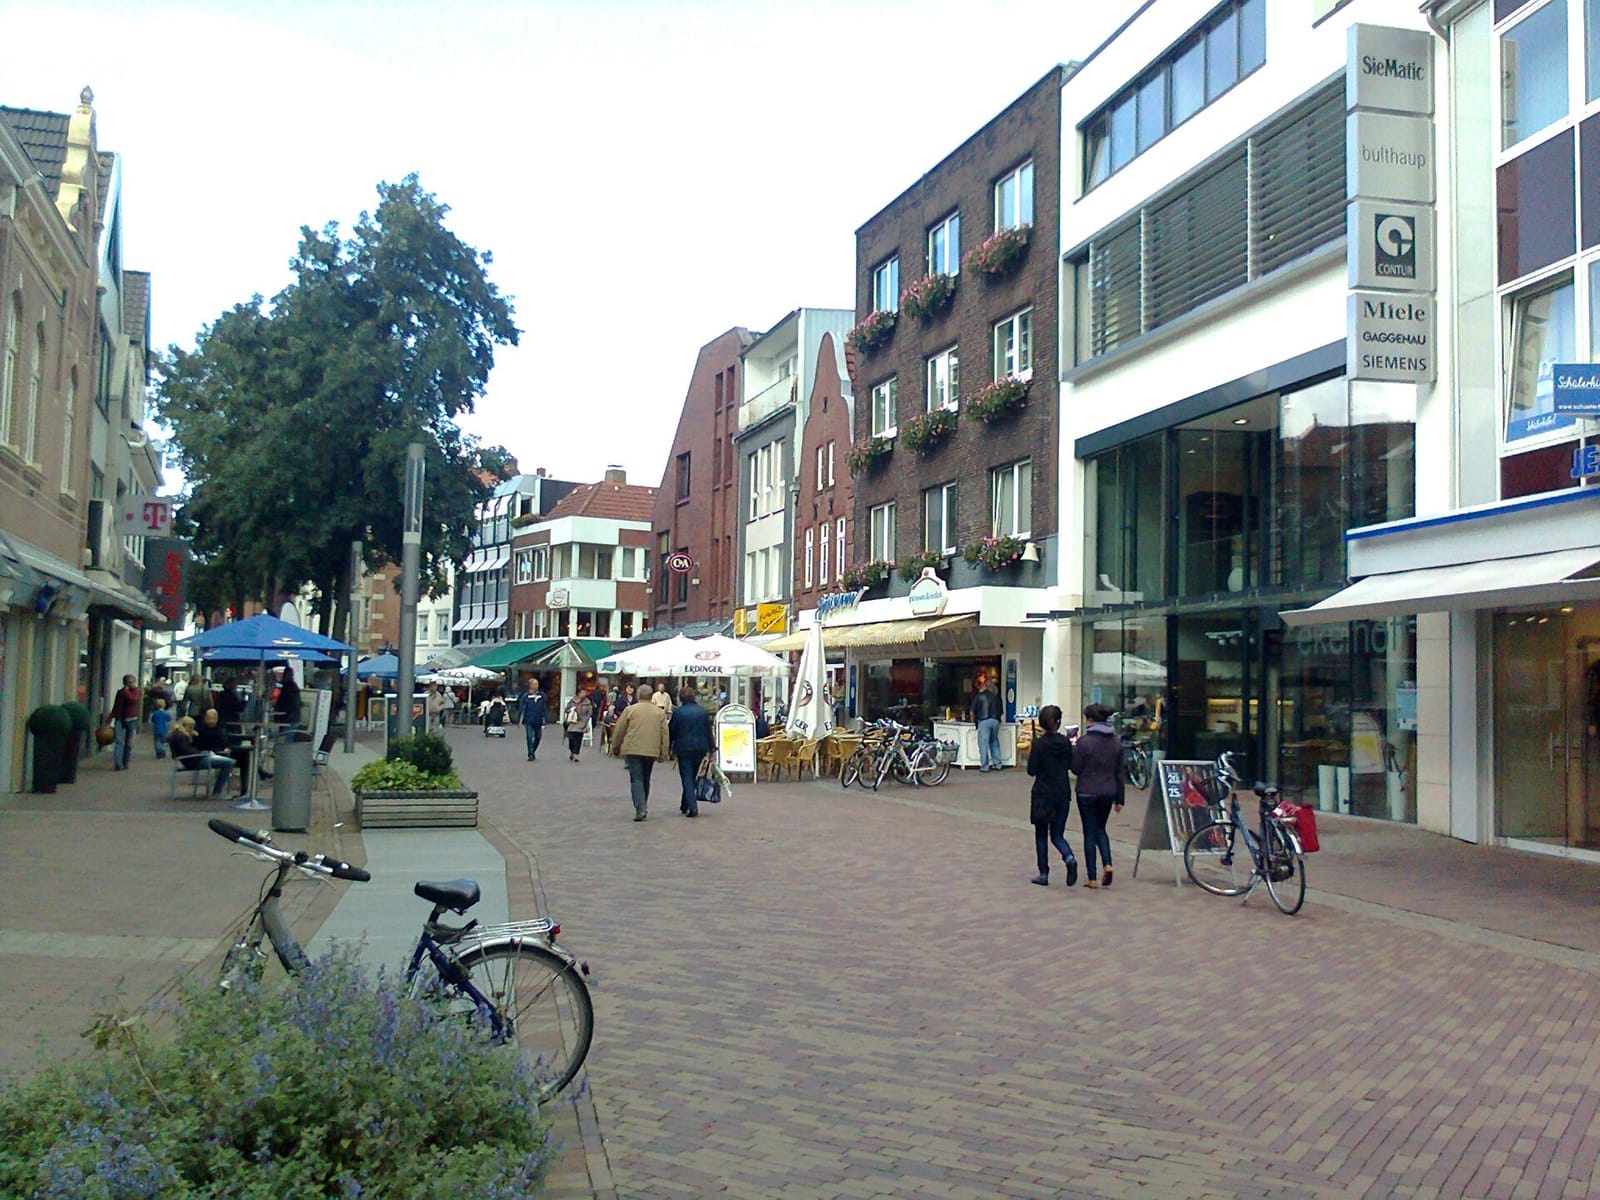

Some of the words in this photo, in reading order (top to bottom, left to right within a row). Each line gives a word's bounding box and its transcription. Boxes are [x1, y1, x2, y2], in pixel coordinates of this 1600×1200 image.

[1362, 55, 1425, 81] SieMatic
[1361, 144, 1426, 170] bulthaup
[1377, 263, 1413, 277] CONTUR
[1364, 301, 1425, 321] Miele
[1363, 331, 1426, 345] GAGGENAU
[1363, 354, 1427, 371] SIEMENS
[684, 664, 724, 674] ERDINGER
